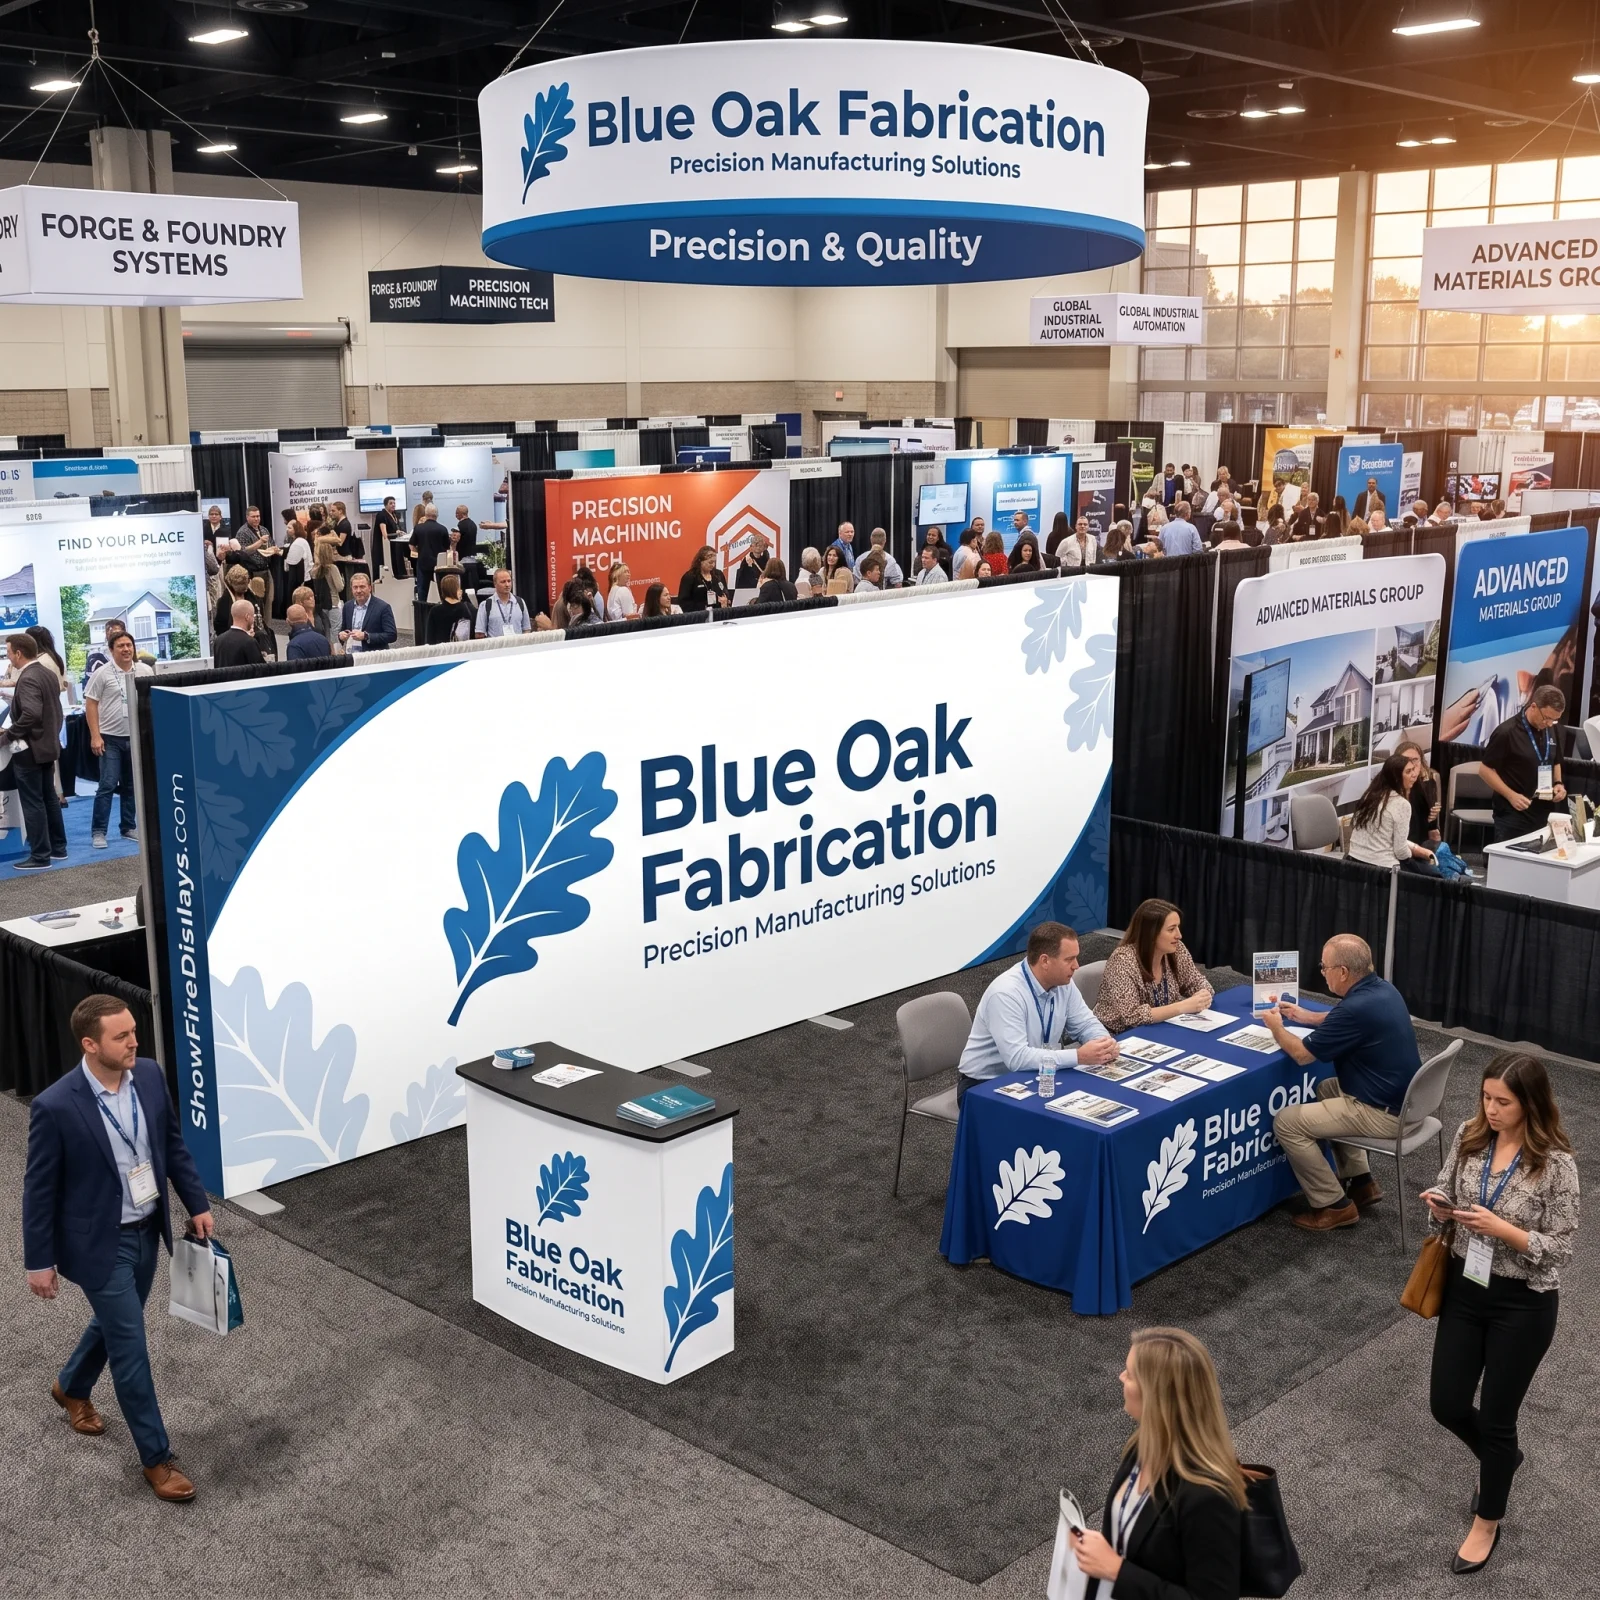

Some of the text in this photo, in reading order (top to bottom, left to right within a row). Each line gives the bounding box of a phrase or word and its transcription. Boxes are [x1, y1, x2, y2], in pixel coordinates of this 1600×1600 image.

[587, 88, 1105, 157] Blue Oak Fabrication
[670, 151, 1021, 178] Precision Manufacturing Solutions
[41, 212, 287, 248] FORGE & FOUNDRY
[650, 227, 983, 267] Precision & Quality
[1471, 238, 1598, 264] ADVANCED
[113, 250, 228, 277] SYSTEMS
[371, 279, 438, 296] FORGE & FOUNDRY
[469, 279, 530, 293] PRECISION
[1433, 268, 1552, 291] MATERIALS
[389, 296, 421, 309] SYSTEMS
[450, 295, 549, 310] MACHINING TECH
[1053, 300, 1092, 312] GLOBAL
[1119, 305, 1199, 319] GLOBAL INDUSTRIAL
[1044, 313, 1102, 326] INDUSTRIAL
[1132, 320, 1186, 332] AUTOMATION
[1040, 327, 1105, 340] AUTOMATION
[572, 494, 672, 520] PRECISION
[58, 531, 185, 551] FIND YOUR PLACE
[573, 520, 681, 547] MACHINING
[572, 551, 622, 573] TECH
[1473, 556, 1569, 598] ADVANCED
[1255, 583, 1424, 626] ADVANCED MATERIALS GROUP
[1479, 592, 1562, 623] MATERIALS GROUP
[640, 702, 973, 837] Blue Oak
[642, 789, 998, 924] Fabrication
[643, 856, 996, 969] Precision Manufacturing Solutions
[1204, 1072, 1317, 1148] Blue Oak
[1202, 1153, 1287, 1199] Precision Manufacturing
[506, 1217, 624, 1291] Blue Oak
[506, 1249, 624, 1318] Fabrication
[506, 1277, 625, 1334] Precision Manufacturing Solutions
